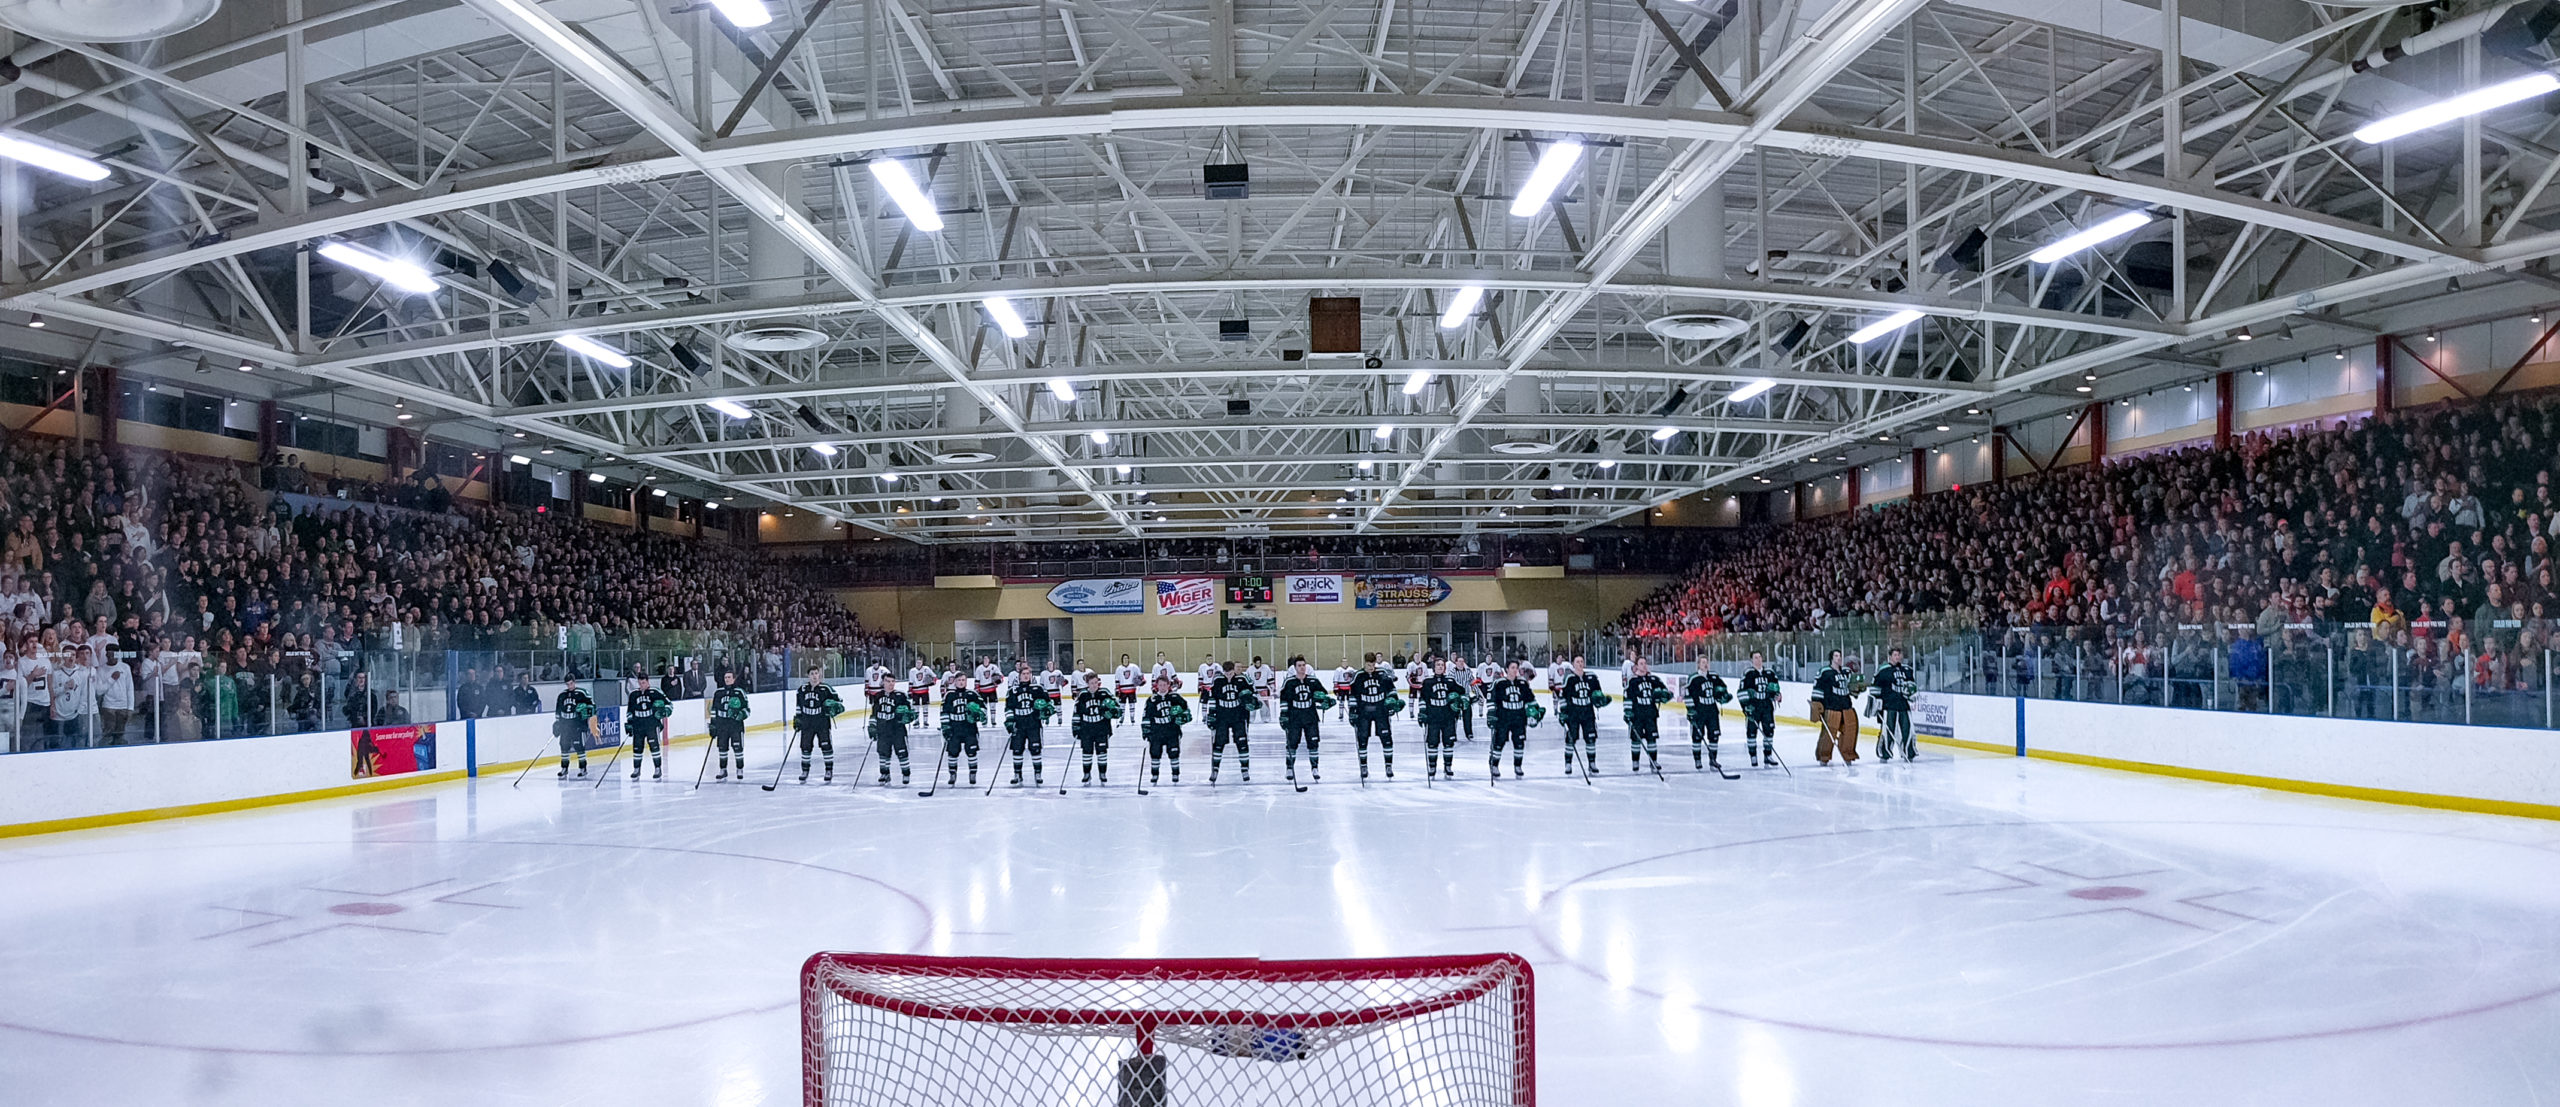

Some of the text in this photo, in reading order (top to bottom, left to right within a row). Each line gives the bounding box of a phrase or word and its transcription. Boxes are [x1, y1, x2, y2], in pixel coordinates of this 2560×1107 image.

[1239, 577, 1262, 587] 17:00
[1234, 590, 1242, 601] 0
[1264, 590, 1272, 601] 0
[1376, 589, 1429, 598] STRAUSS
[1363, 679, 1380, 688] HILL
[1432, 683, 1448, 692] HILL
[1222, 684, 1238, 693] HILL
[1295, 684, 1311, 694] HILL
[1505, 686, 1521, 695] HILL
[636, 696, 651, 705] HILL
[804, 692, 819, 701] HILL
[1017, 693, 1034, 703] HILL
[1085, 699, 1101, 708] HILL
[1918, 704, 1948, 714] URGENCY
[1926, 713, 1946, 725] ROOM
